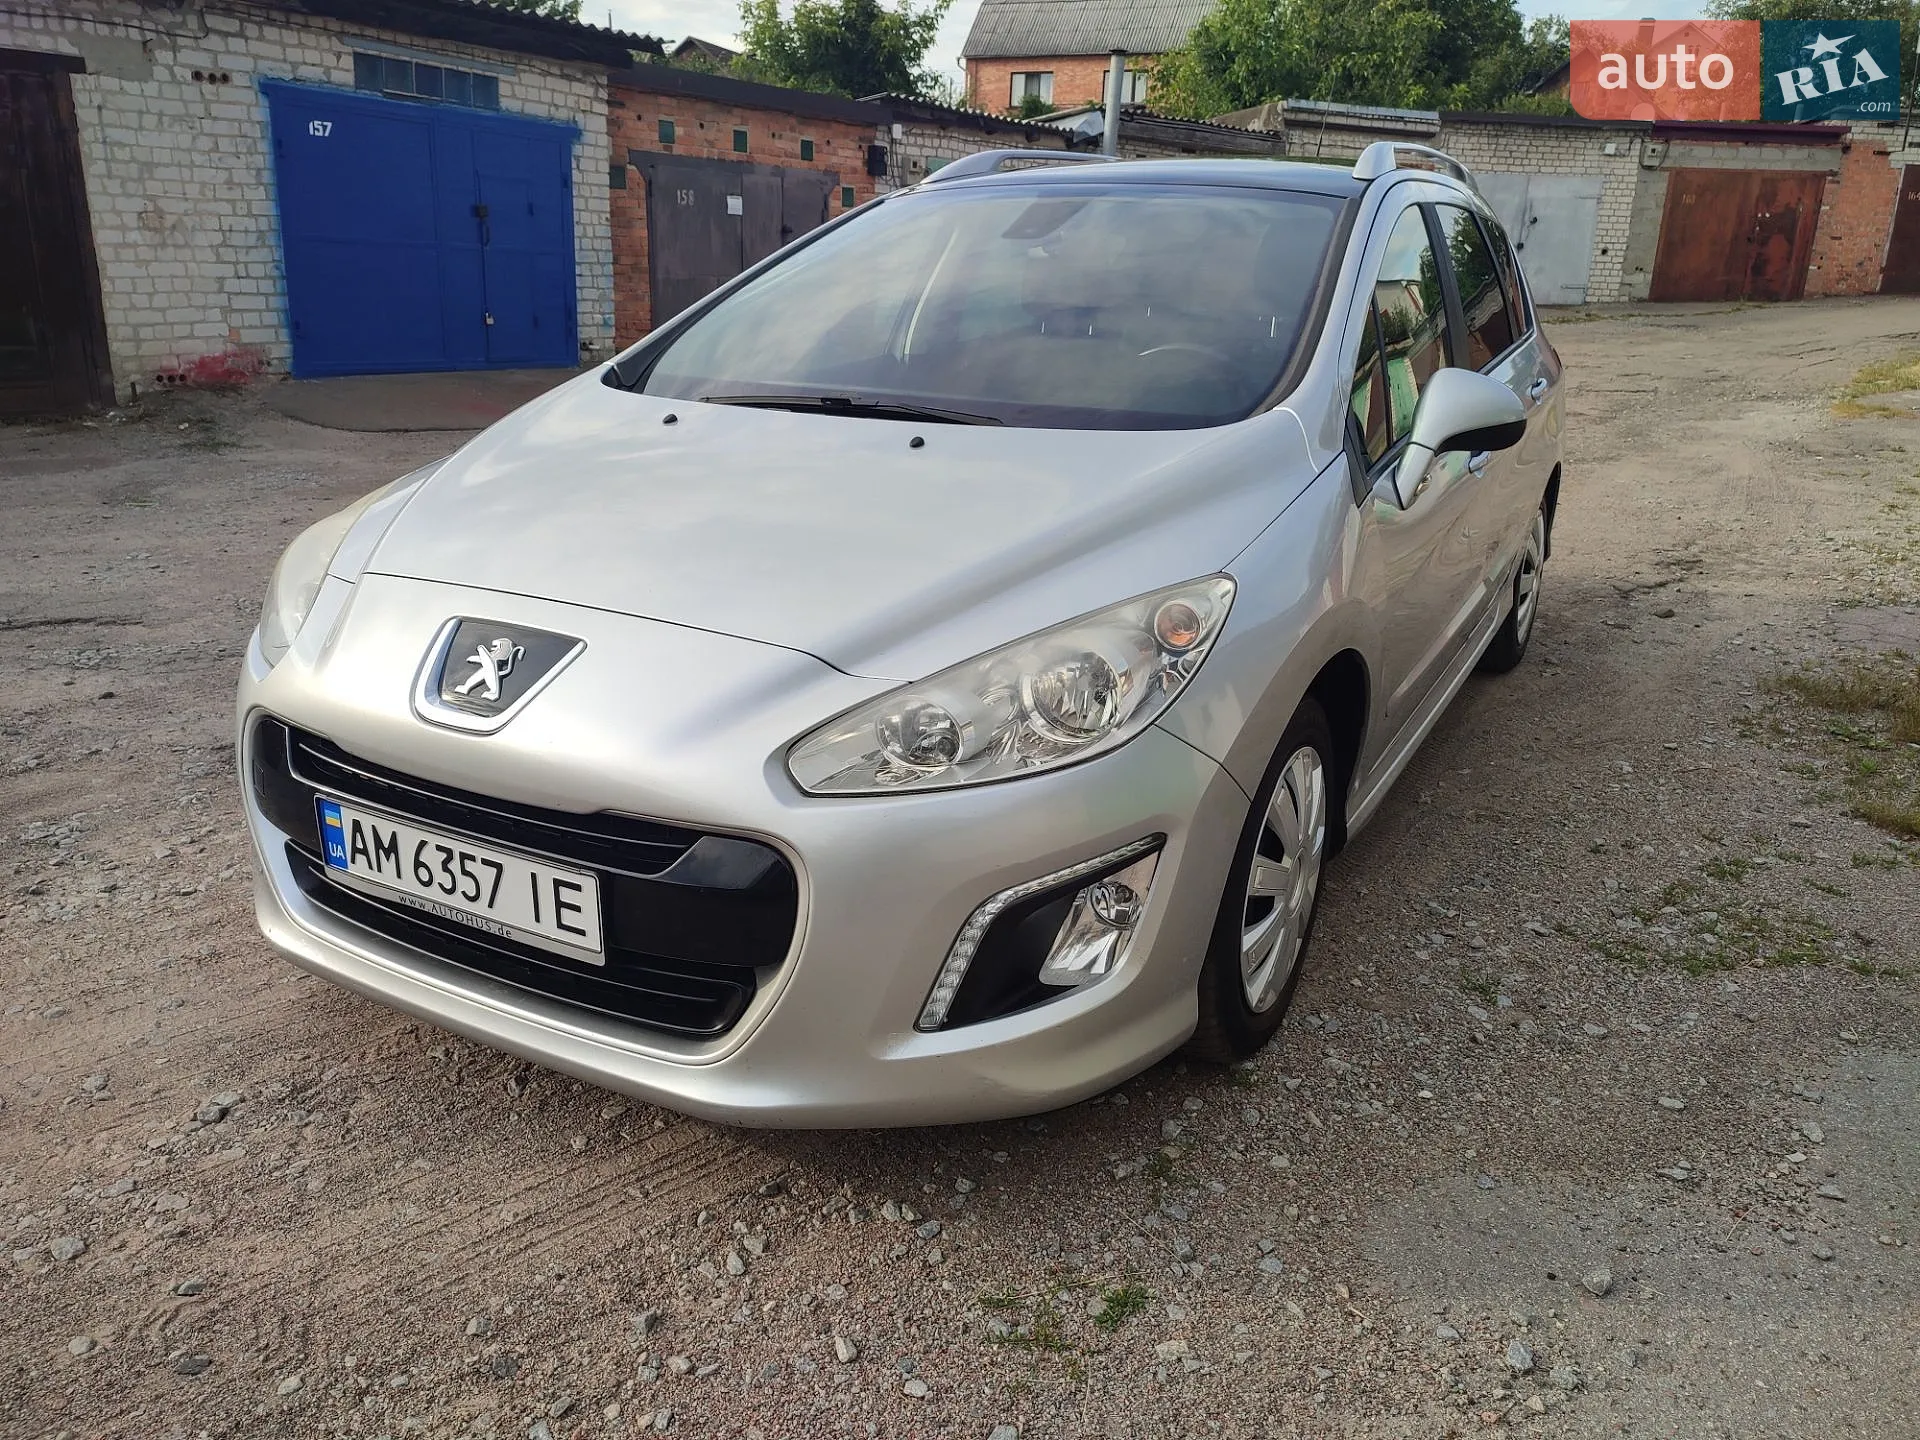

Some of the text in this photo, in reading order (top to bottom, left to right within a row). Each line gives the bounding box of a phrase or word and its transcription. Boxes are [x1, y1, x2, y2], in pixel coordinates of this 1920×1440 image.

[309, 120, 332, 137] 157
[677, 189, 695, 206] 158
[329, 843, 345, 860] UA
[350, 818, 588, 937] AM 6357 IE
